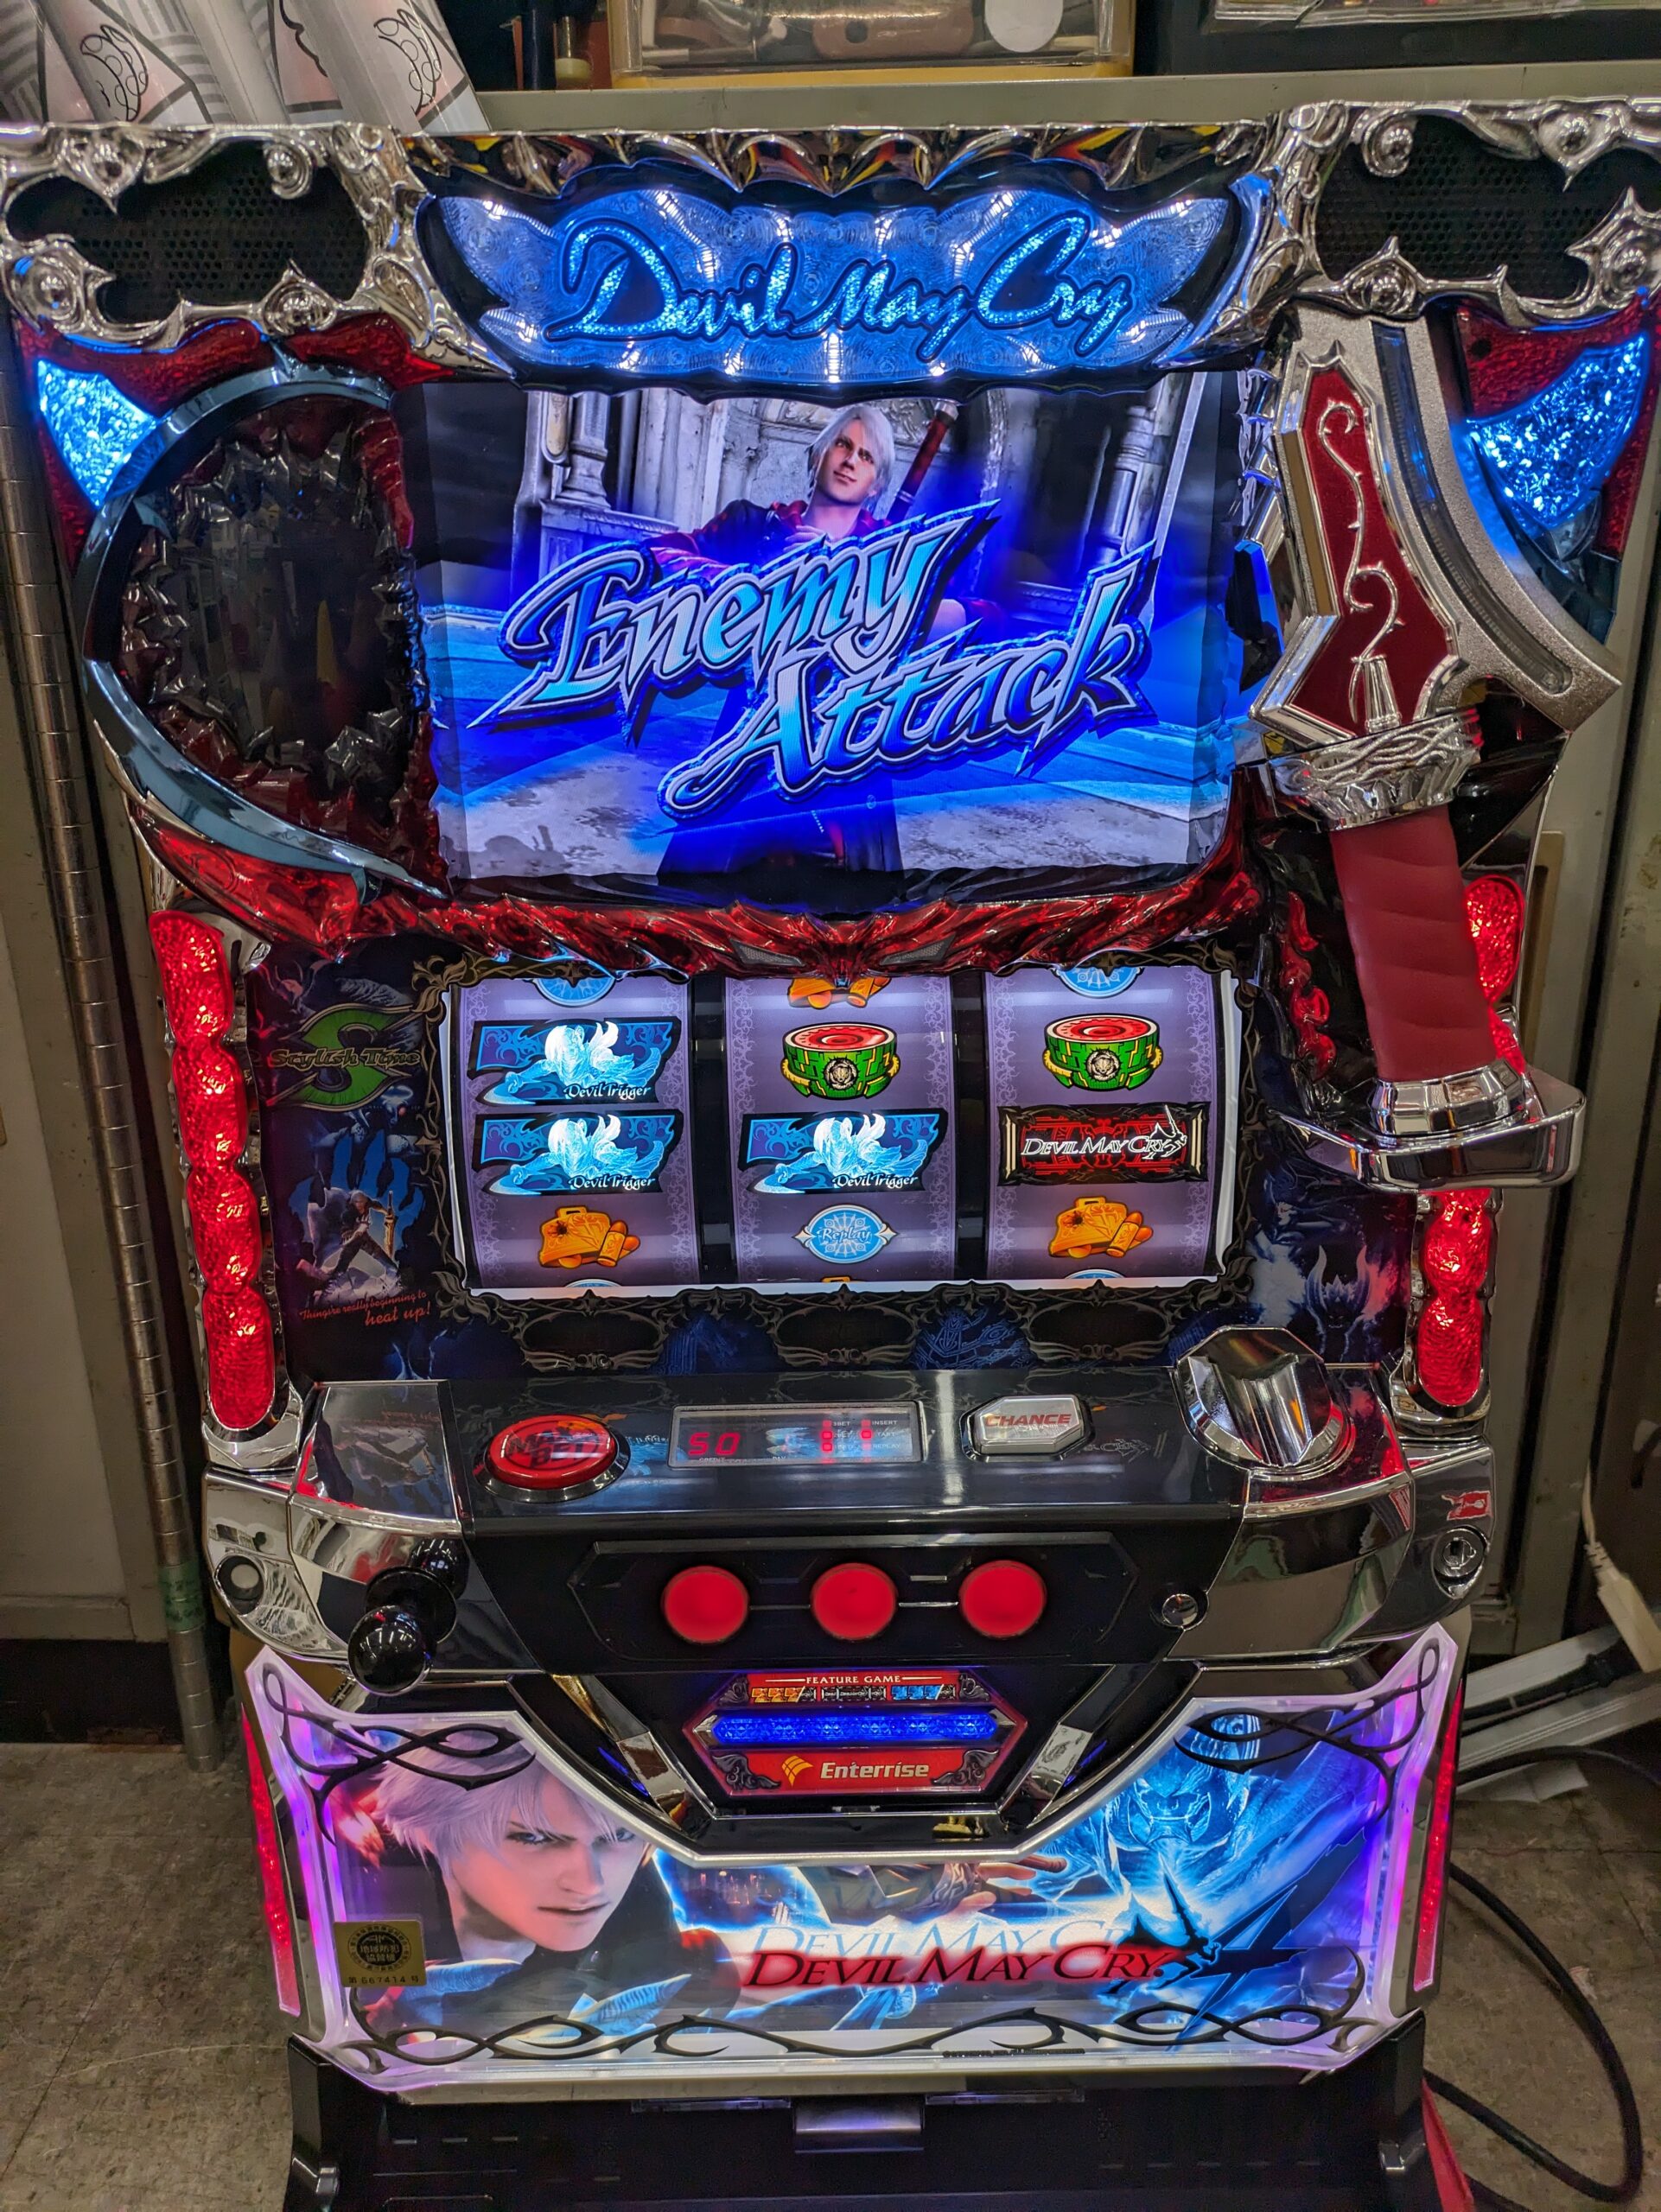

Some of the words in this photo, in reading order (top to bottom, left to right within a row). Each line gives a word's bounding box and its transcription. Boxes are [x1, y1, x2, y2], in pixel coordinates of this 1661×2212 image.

[549, 216, 796, 340] Devil
[793, 259, 969, 359] May
[976, 214, 1134, 356] Cry
[469, 503, 996, 739] Enemy
[659, 543, 1156, 817] Attack
[563, 1084, 603, 1099] Devil
[602, 1084, 651, 1100] Trigger
[1021, 1137, 1079, 1155] DEVIL
[1079, 1136, 1129, 1154] MAY
[569, 1175, 608, 1189] Devil
[607, 1175, 655, 1190] Trigger
[832, 1173, 871, 1187] Devil
[871, 1174, 918, 1188] Trigger
[817, 1226, 871, 1244] Replay
[418, 1289, 427, 1299] to
[365, 1306, 398, 1326] heat
[404, 1300, 430, 1322] up!
[985, 1414, 1072, 1427] CHANCE
[688, 1431, 741, 1456] 50
[806, 1675, 859, 1684] FEATURE
[821, 1762, 929, 1779] Enterrise
[743, 1951, 905, 1986] DEVIL
[912, 1945, 1053, 1982] MAY
